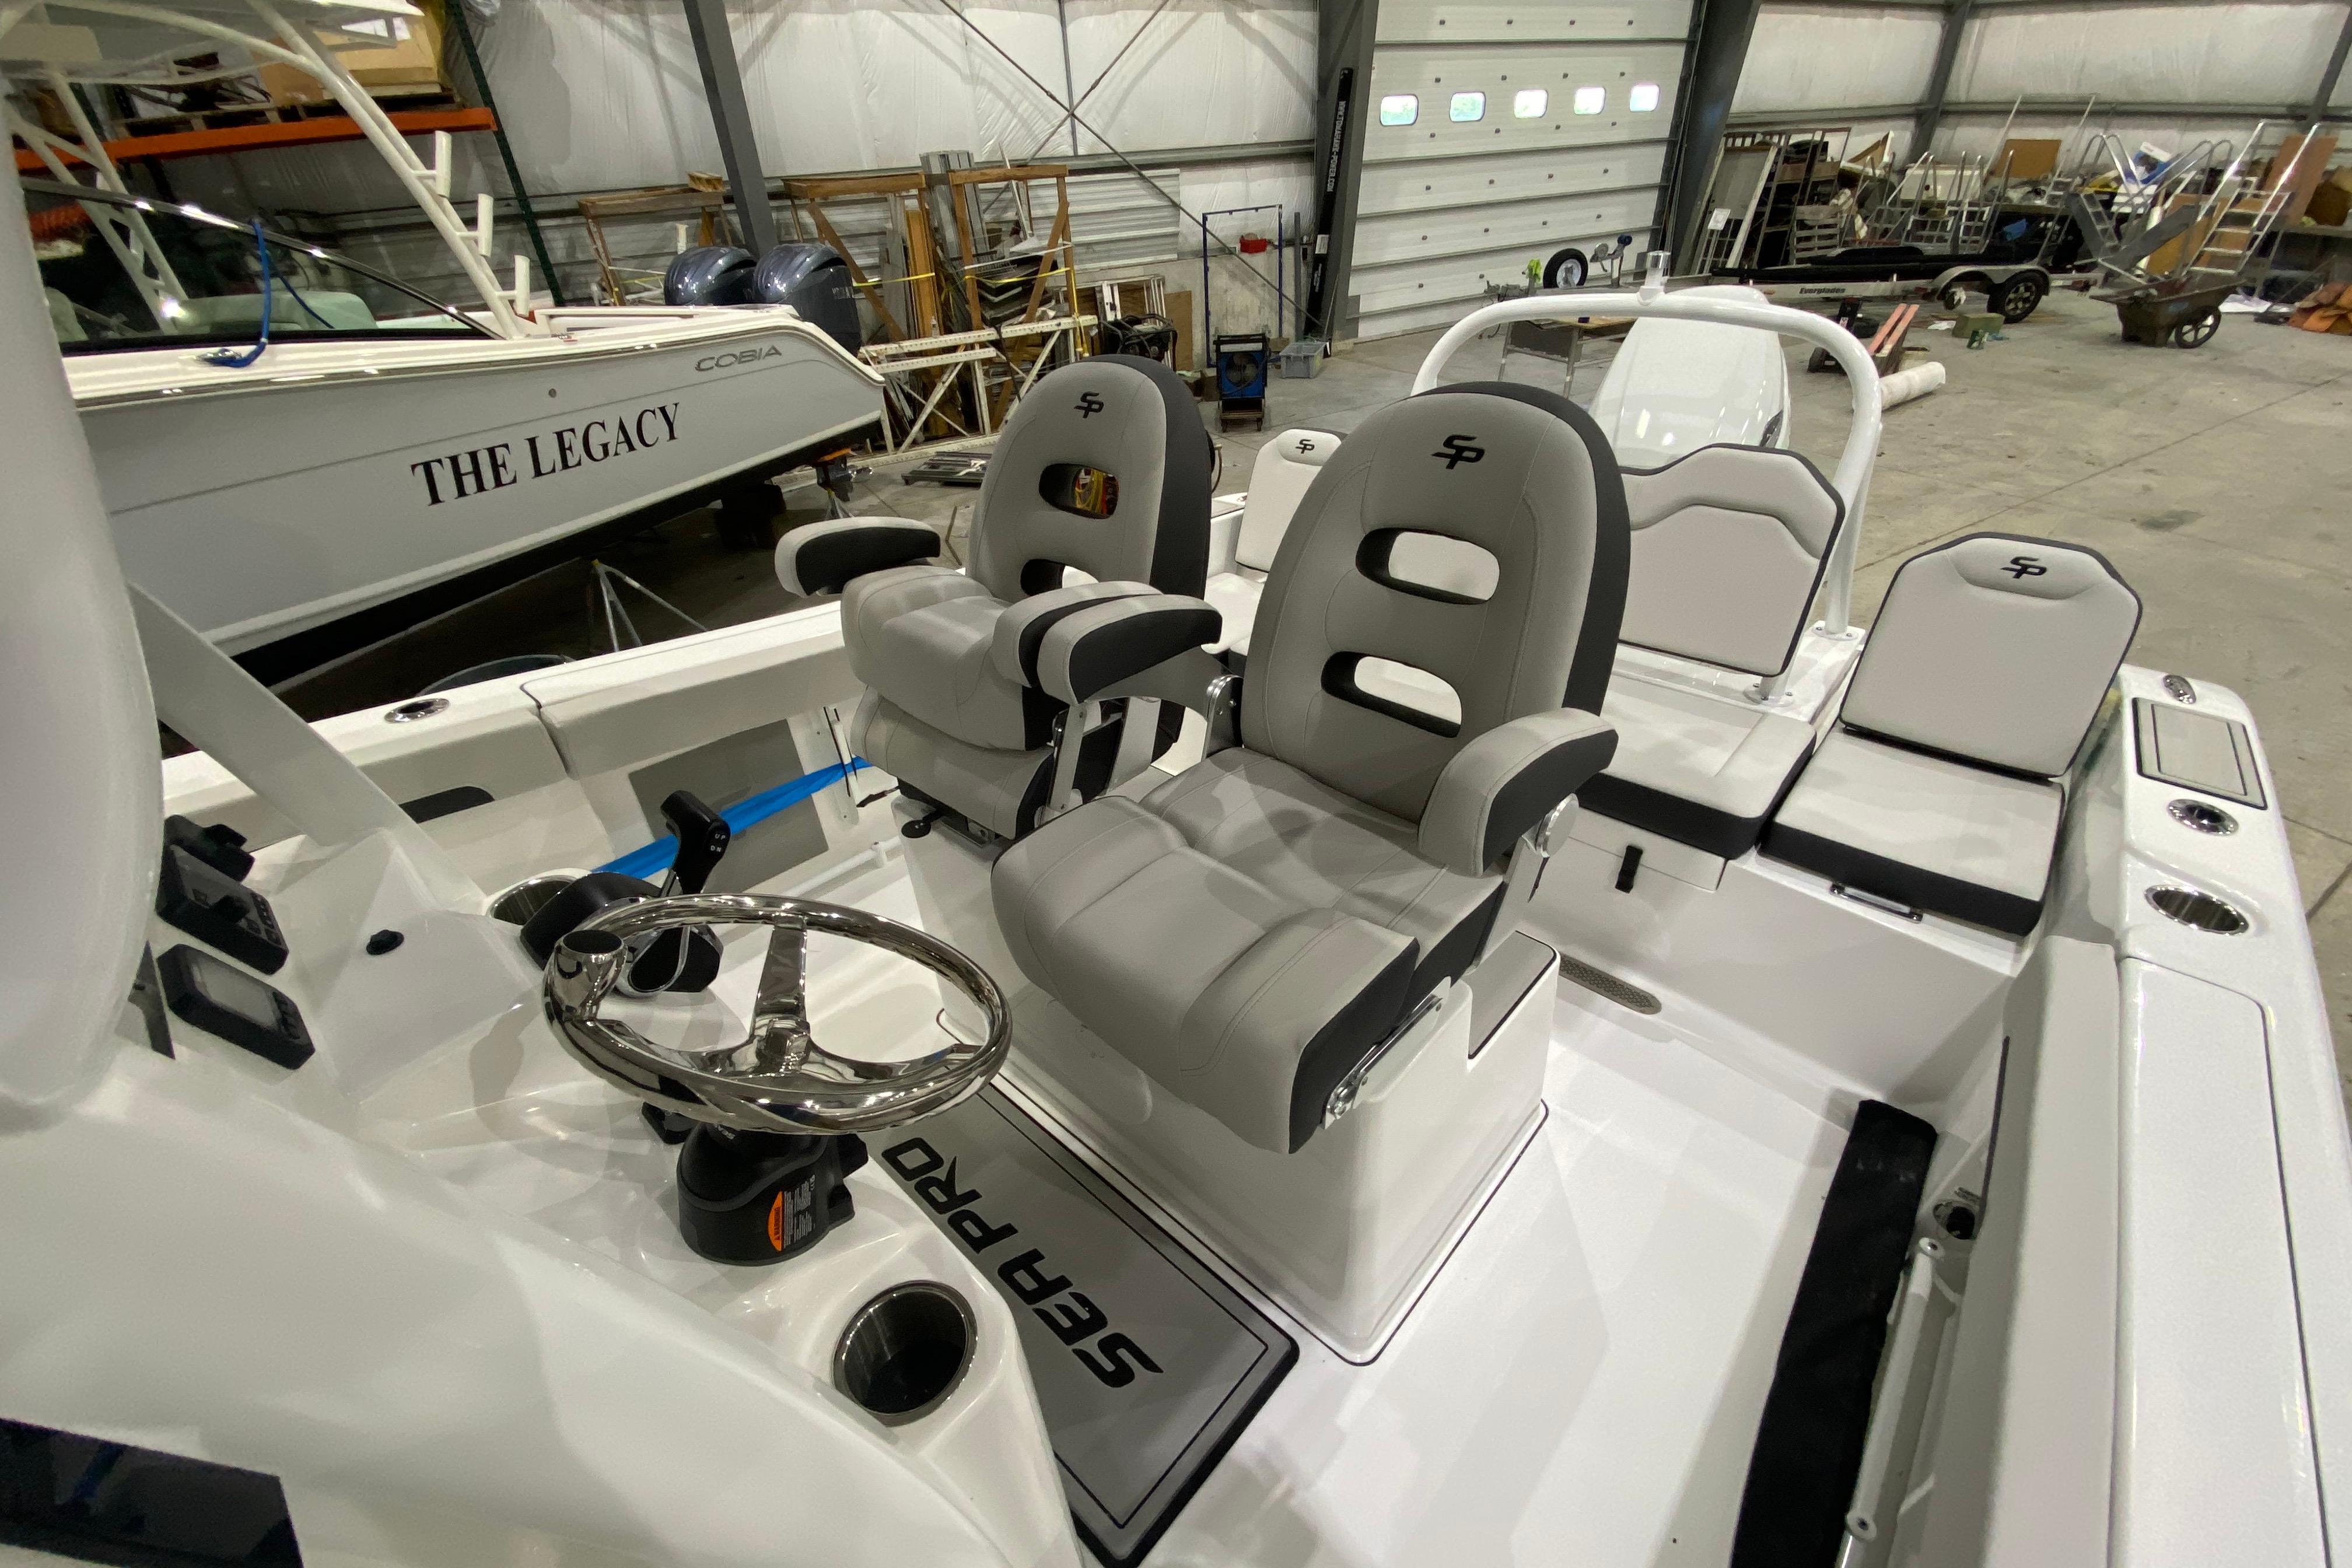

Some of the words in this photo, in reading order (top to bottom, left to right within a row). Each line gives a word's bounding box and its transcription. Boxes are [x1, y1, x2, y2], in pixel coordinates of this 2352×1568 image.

[695, 345, 782, 372] COBIA
[411, 442, 517, 506] THE
[524, 402, 680, 479] LEGACY
[881, 1137, 1019, 1254] PRO
[998, 1248, 1164, 1388] SEA
